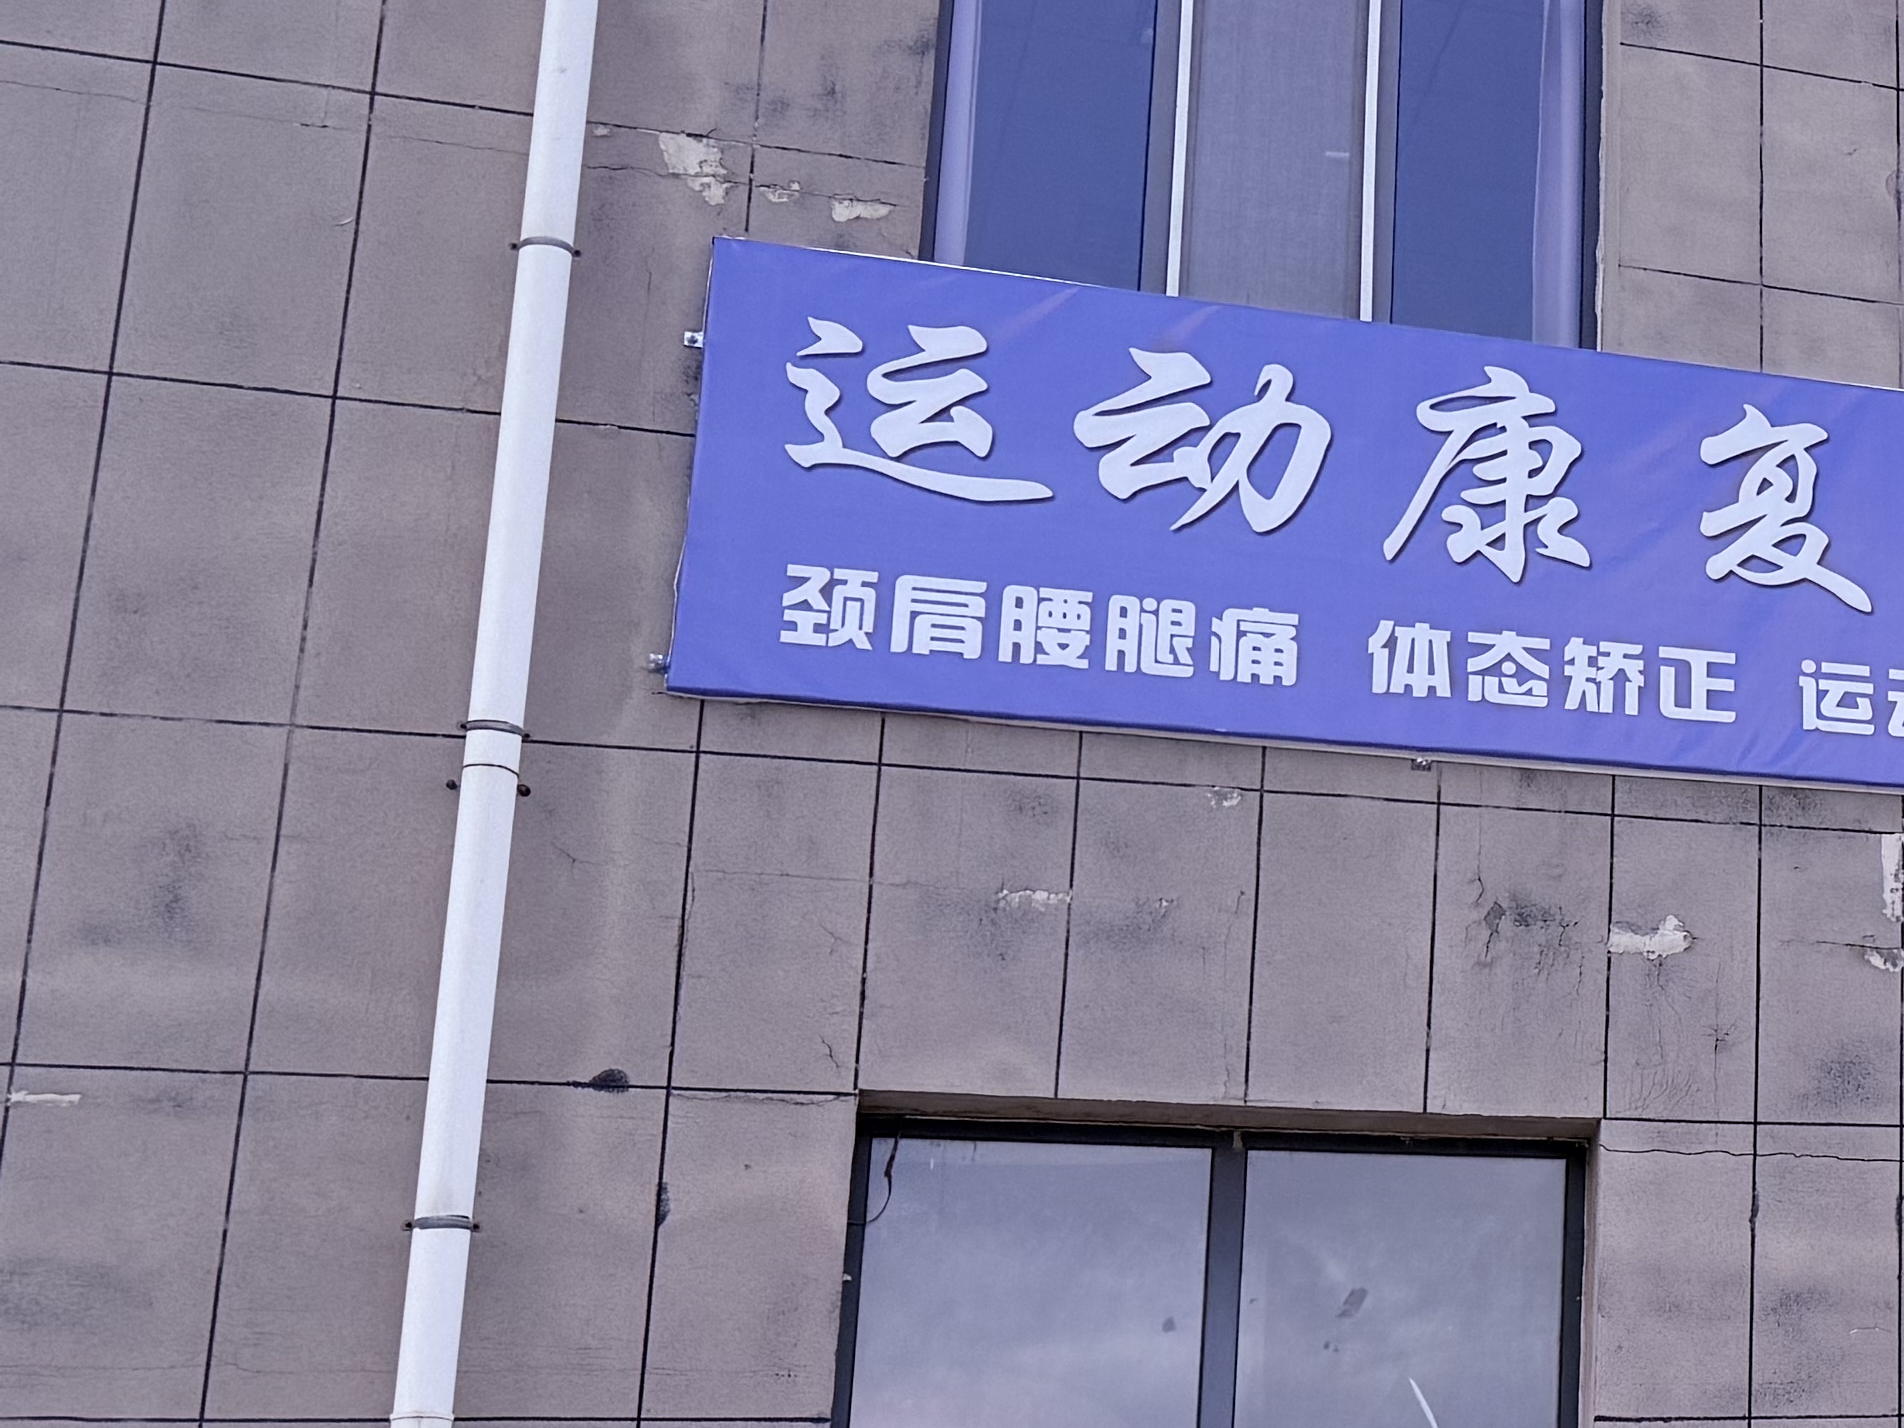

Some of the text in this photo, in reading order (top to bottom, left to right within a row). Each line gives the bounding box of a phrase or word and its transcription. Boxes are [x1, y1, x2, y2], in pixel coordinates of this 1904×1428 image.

[783, 316, 1874, 614] 运动康复
[779, 563, 1300, 687] 颈肩腰腿痛
[1367, 619, 1737, 724] 体态矫正
